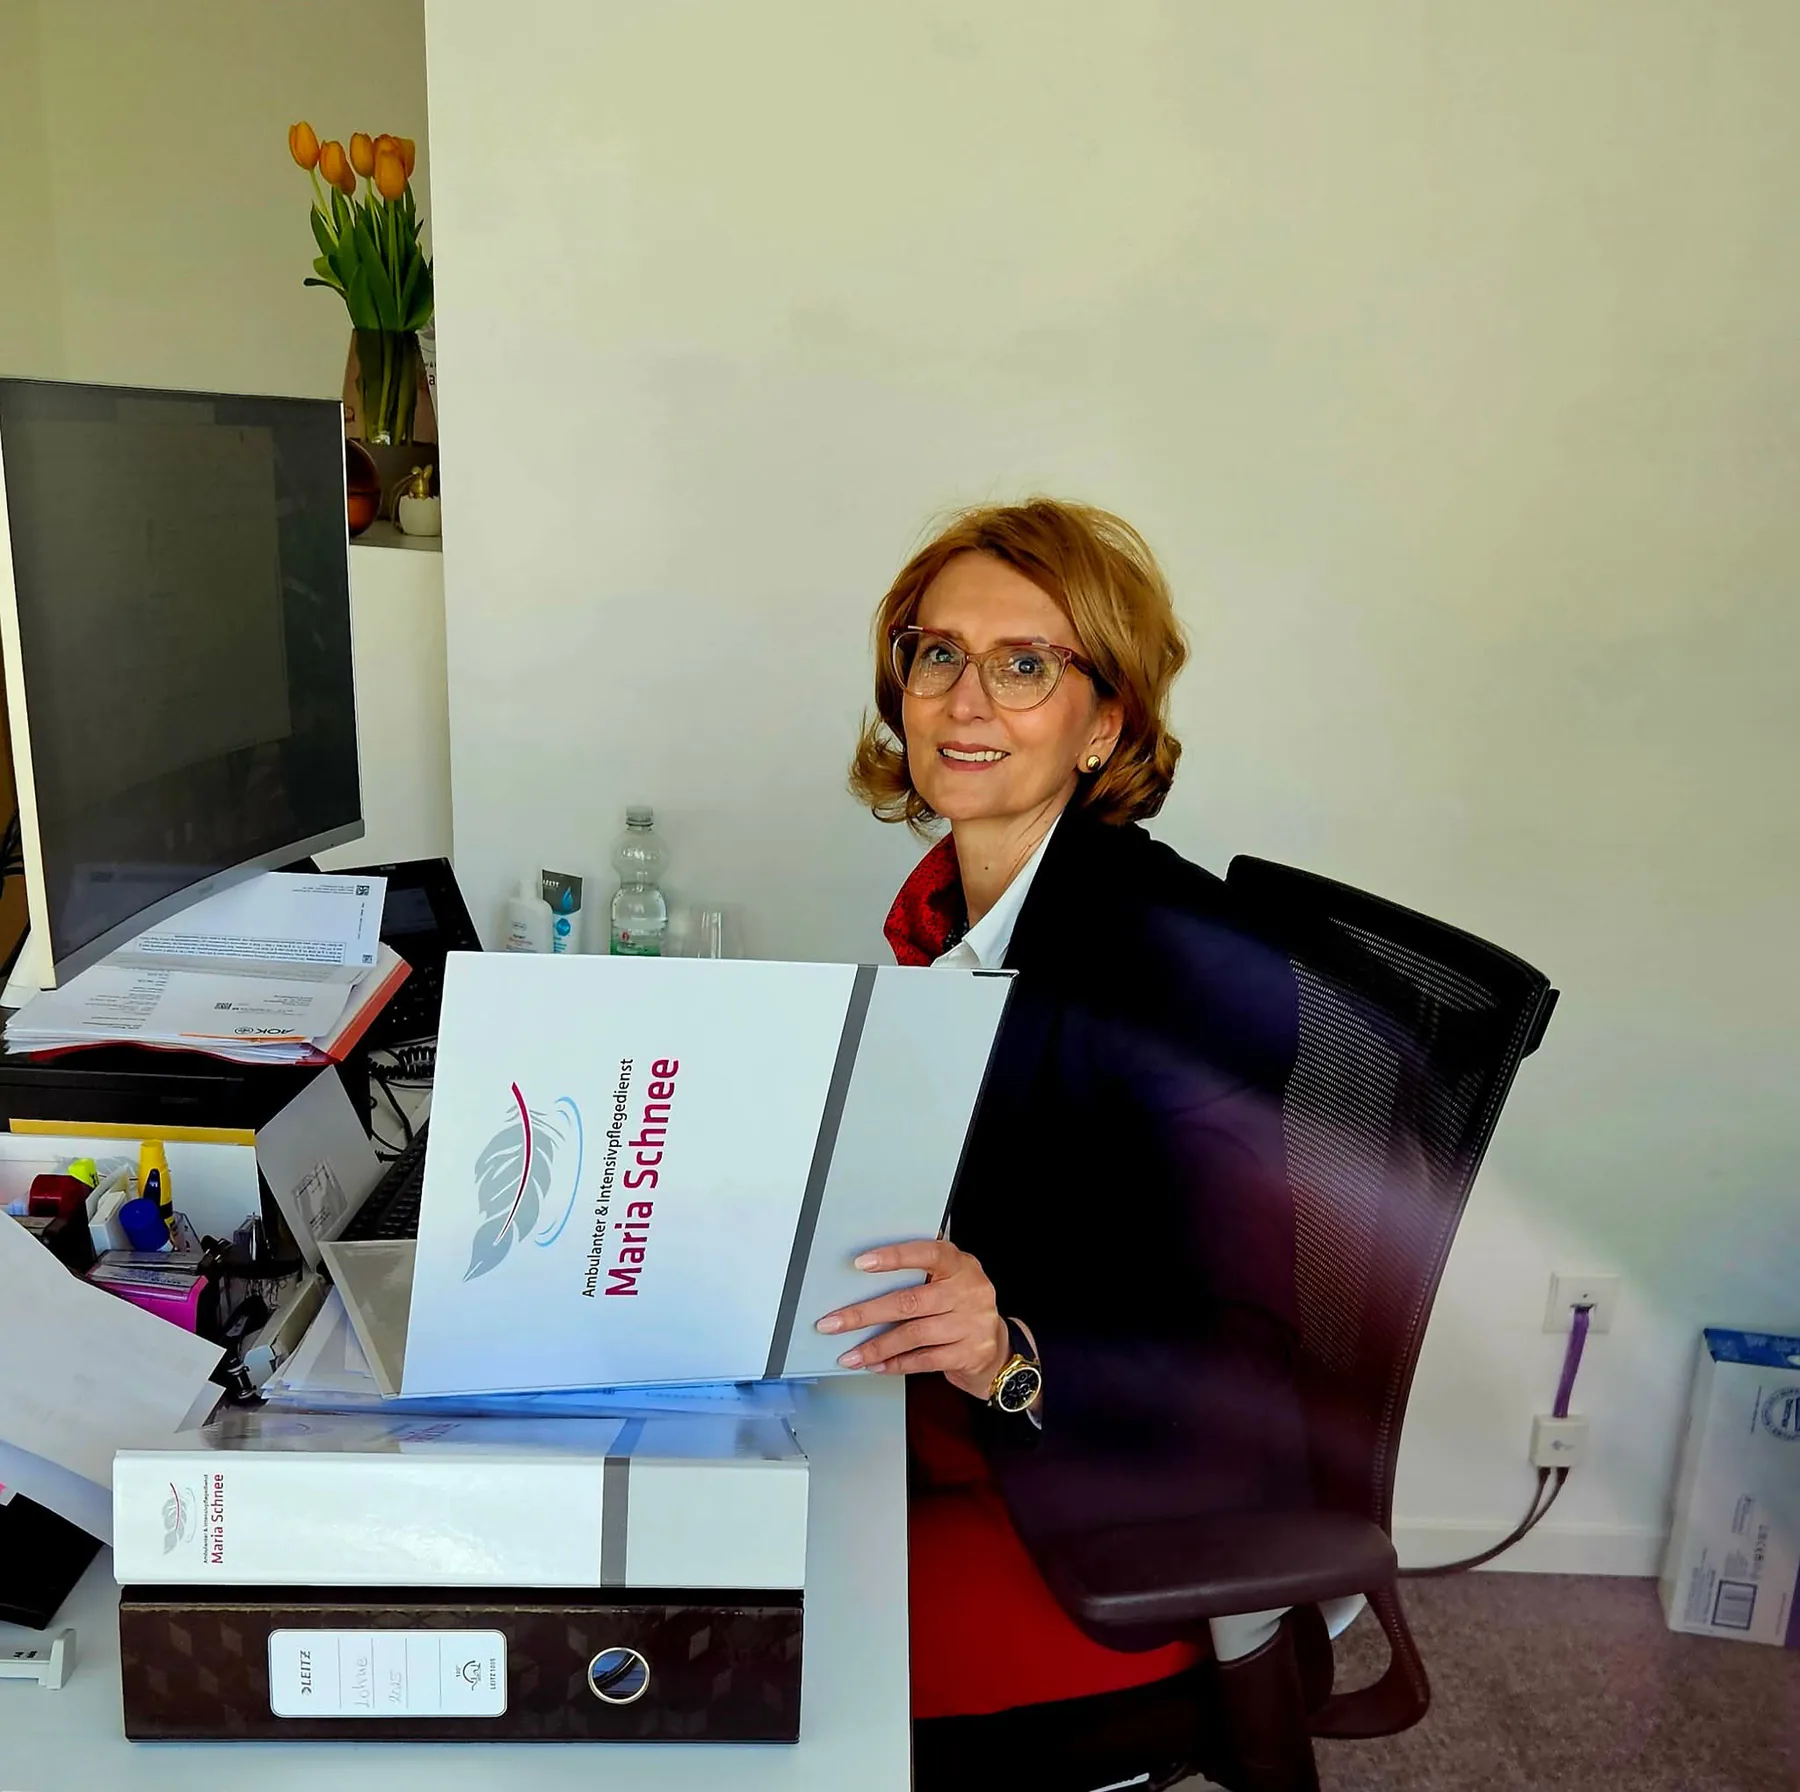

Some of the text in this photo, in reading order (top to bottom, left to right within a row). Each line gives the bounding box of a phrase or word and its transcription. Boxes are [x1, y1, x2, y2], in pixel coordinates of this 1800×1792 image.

[582, 1058, 634, 1298] Ambulanter & Intensivpflegedienst
[605, 1058, 680, 1296] Maria Schnee
[210, 1474, 224, 1564] Maria Schnee
[299, 1650, 312, 1687] LEITZ
